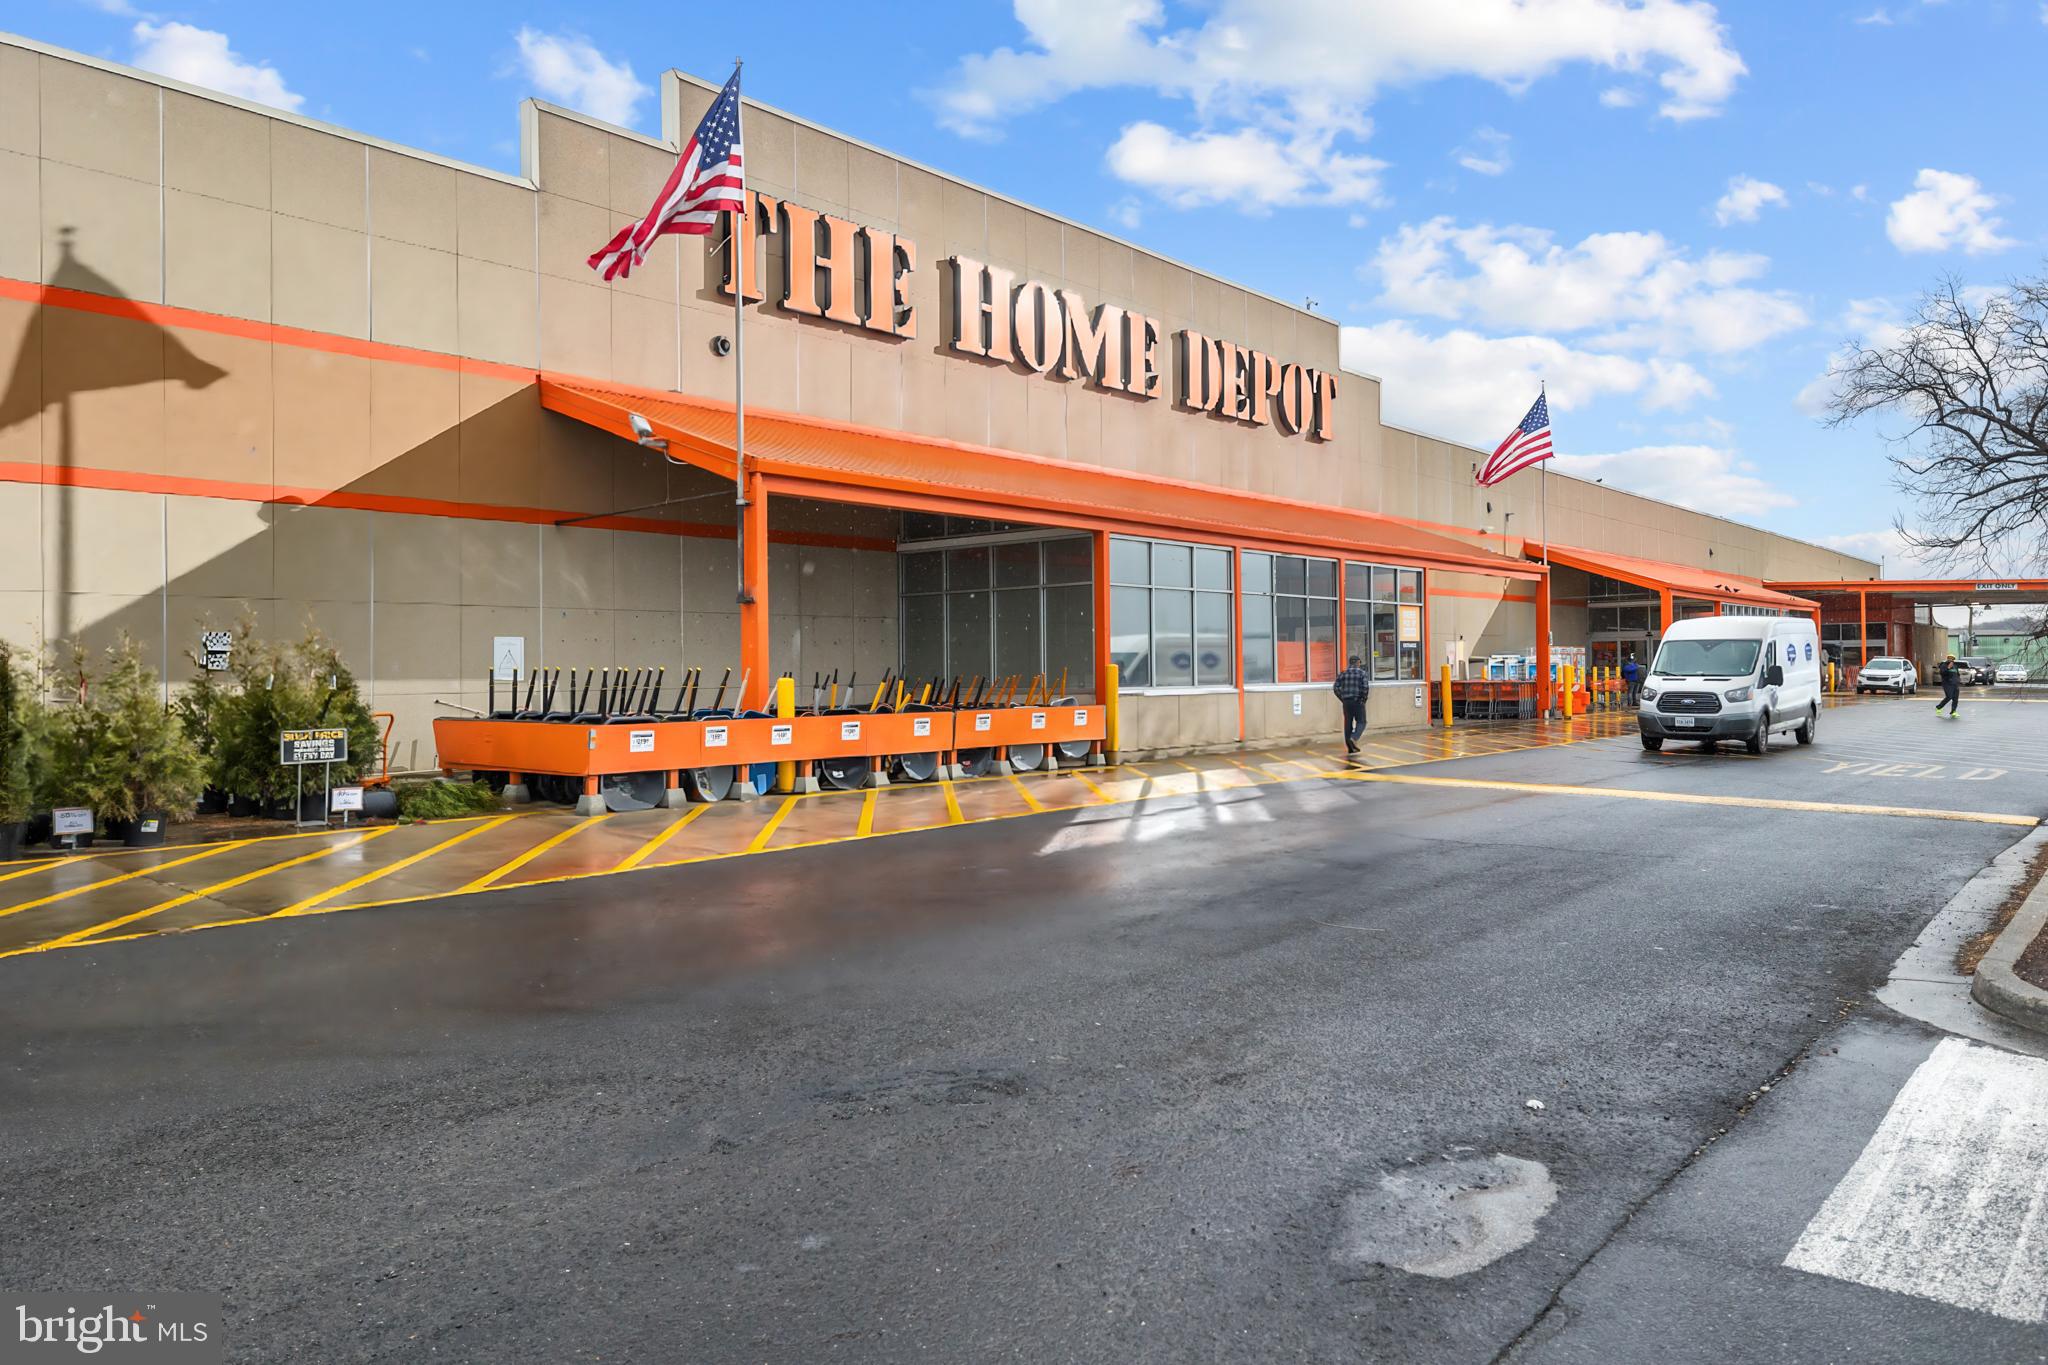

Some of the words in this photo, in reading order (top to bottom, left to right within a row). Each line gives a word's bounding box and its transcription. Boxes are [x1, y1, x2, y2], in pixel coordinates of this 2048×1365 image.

[718, 190, 918, 340] THE
[949, 254, 1161, 400] HOME
[1180, 328, 1339, 443] DEPOT
[293, 739, 335, 748] SAVINGS
[293, 752, 319, 761] EVERY
[320, 751, 335, 760] DAY
[1820, 761, 2010, 781] YIELD
